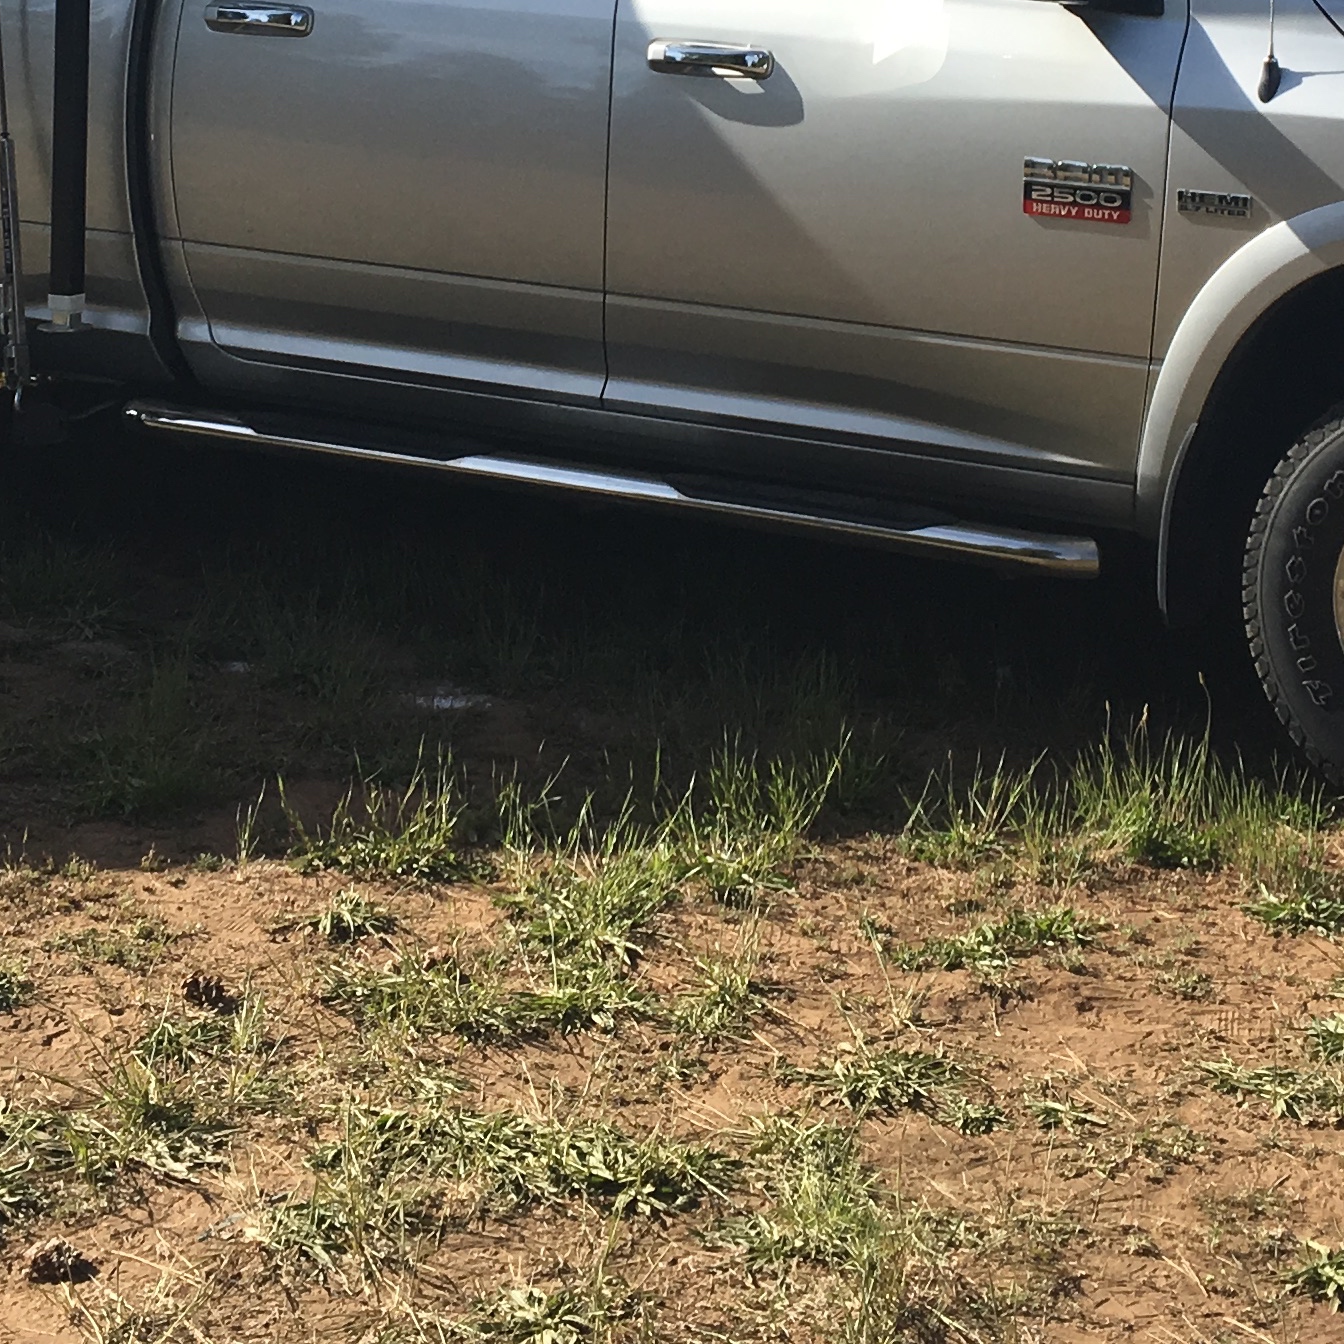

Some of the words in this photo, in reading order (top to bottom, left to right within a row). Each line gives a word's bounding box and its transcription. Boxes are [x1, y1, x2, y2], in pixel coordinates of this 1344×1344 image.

[1031, 185, 1123, 207] 2500
[1032, 202, 1079, 217] HEAVY
[1084, 208, 1121, 220] DUTY
